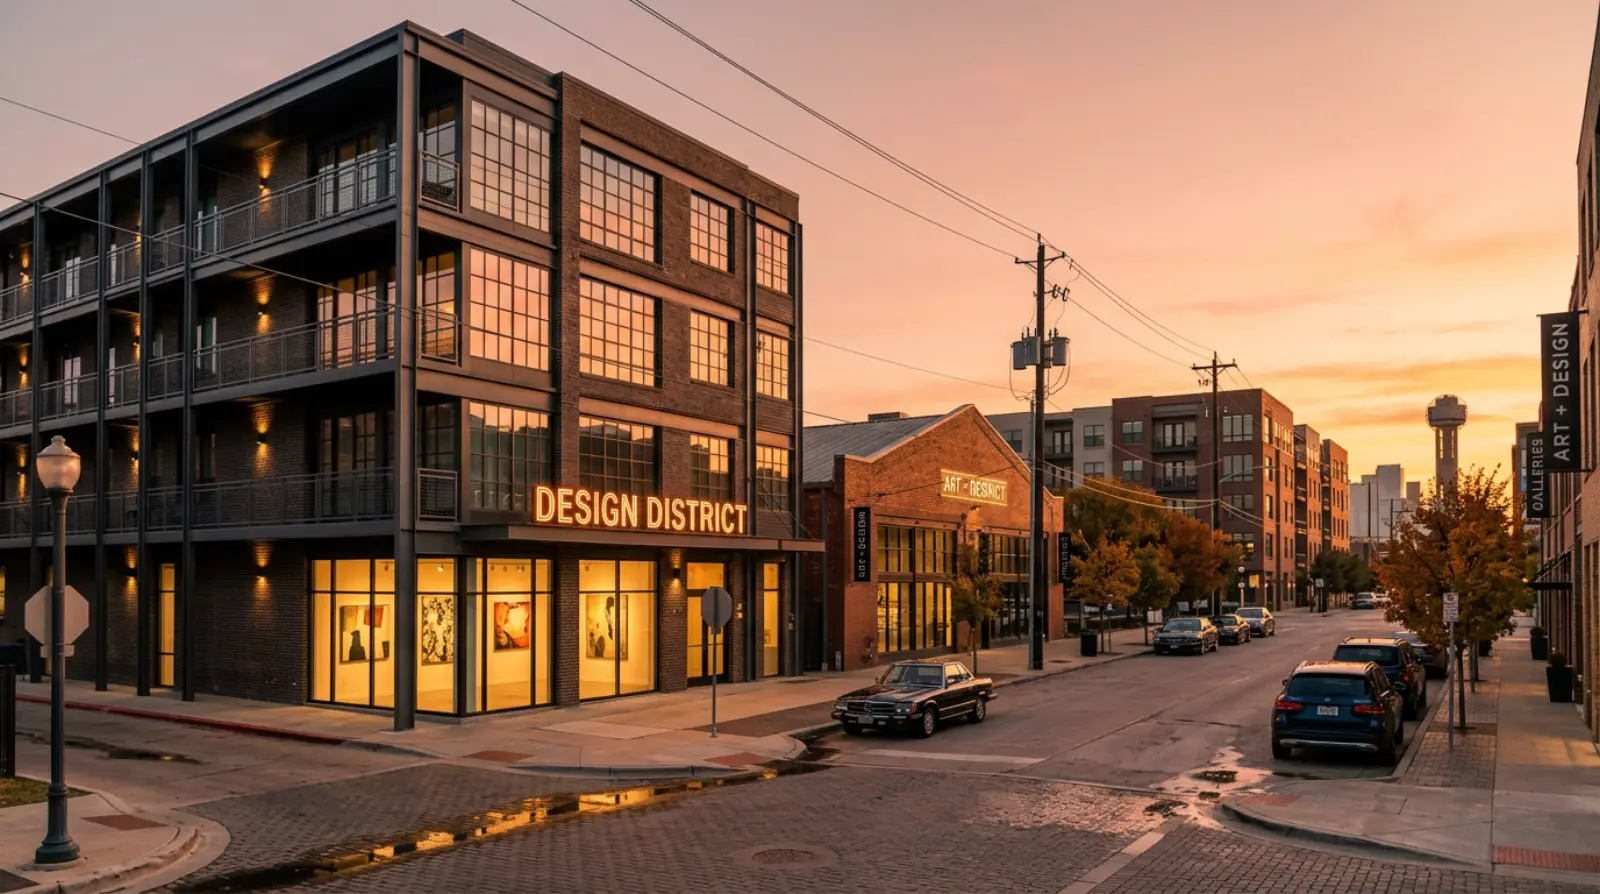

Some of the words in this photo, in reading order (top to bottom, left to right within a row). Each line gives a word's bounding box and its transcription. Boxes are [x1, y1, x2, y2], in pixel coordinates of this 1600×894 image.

[1552, 323, 1570, 397] DESIGN
[1555, 404, 1568, 416] +
[1553, 422, 1570, 461] ART
[943, 475, 962, 493] ART
[535, 486, 638, 528] DESIGN
[646, 496, 748, 534] DISTRICT
